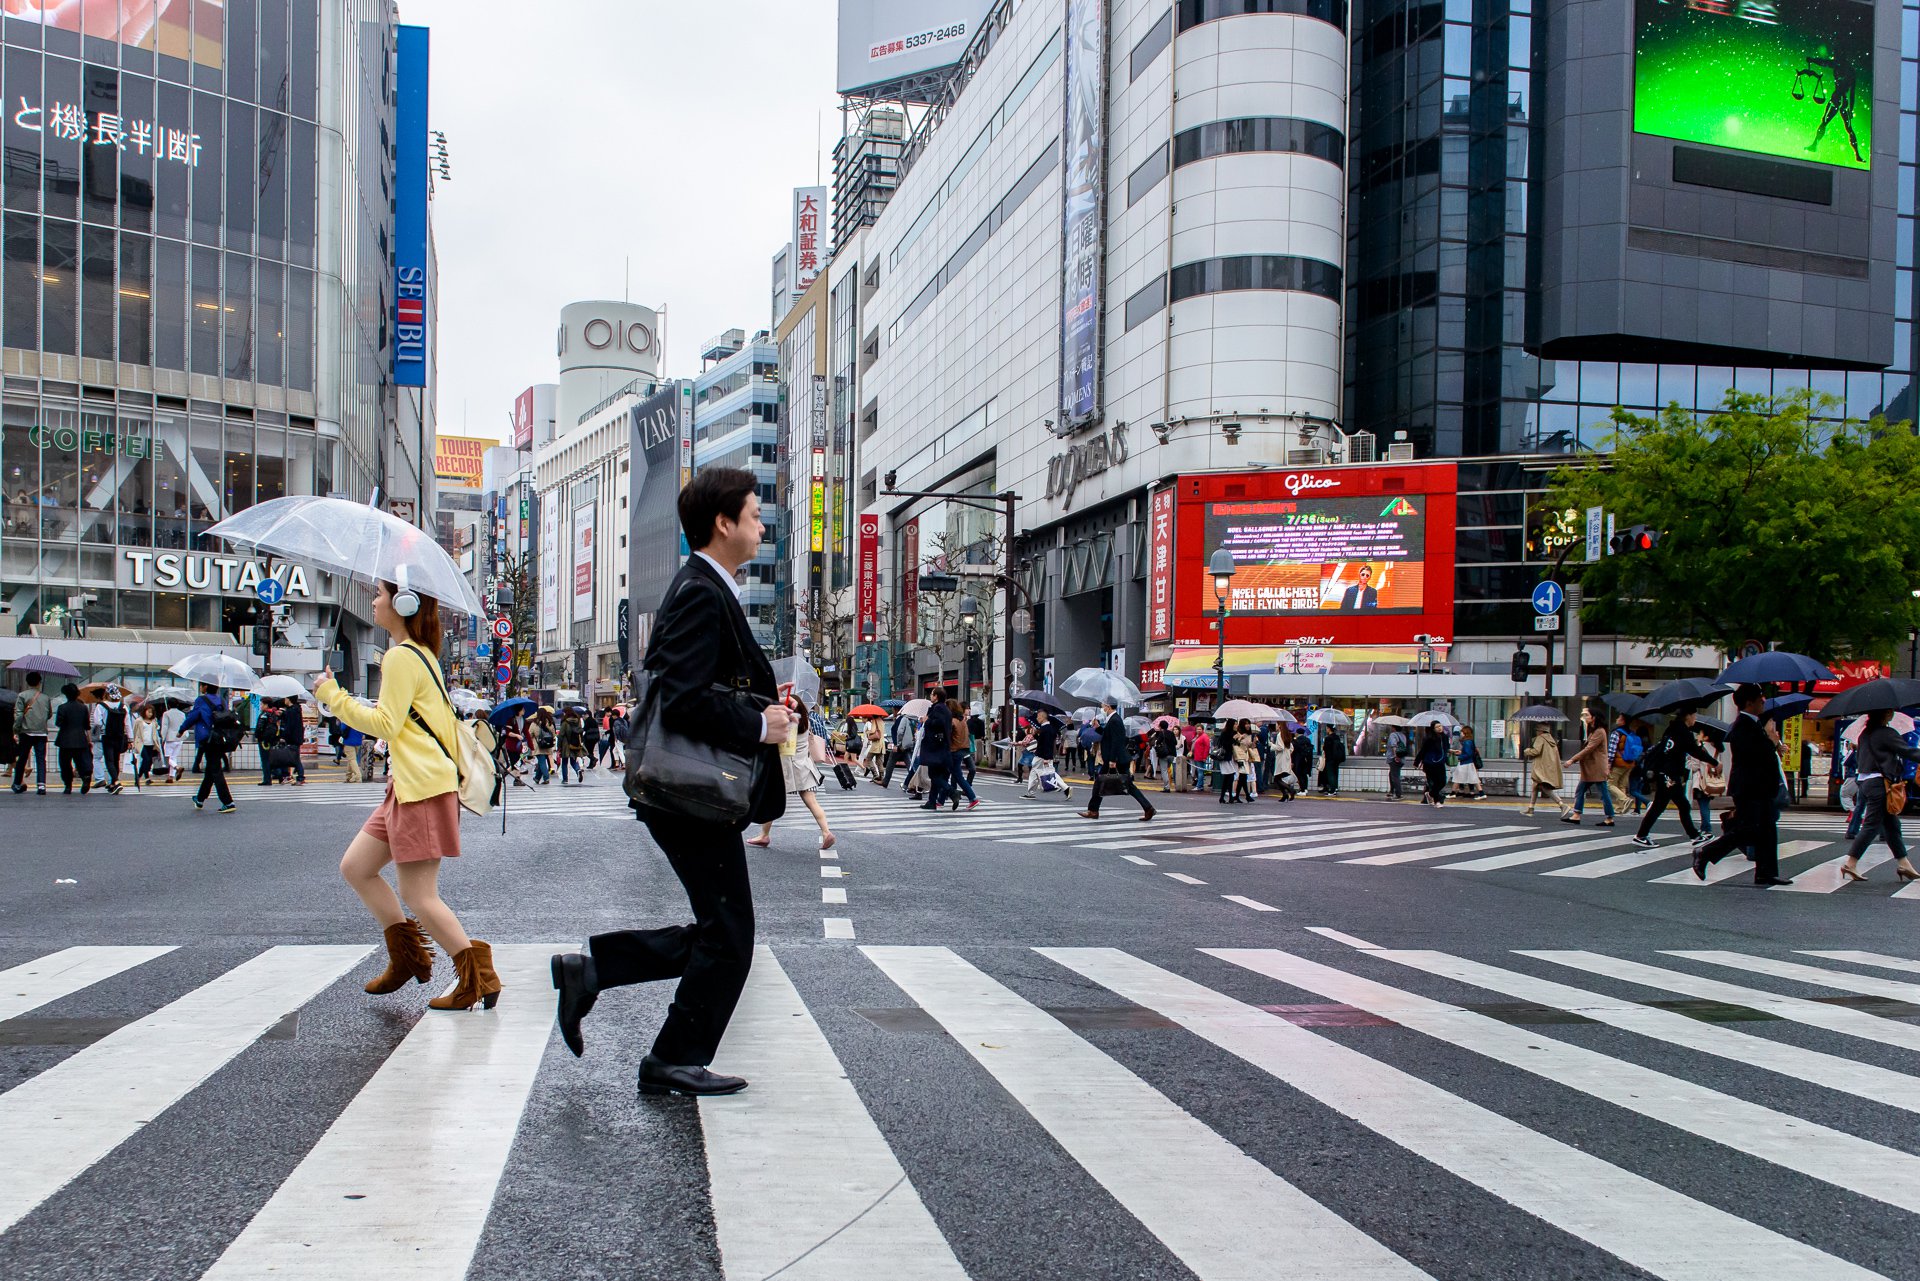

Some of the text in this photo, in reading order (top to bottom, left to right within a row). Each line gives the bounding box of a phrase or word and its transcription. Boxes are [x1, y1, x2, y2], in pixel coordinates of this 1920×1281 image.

[870, 23, 965, 58] 広告募集 5337-2468
[15, 95, 202, 167] と機長判断
[799, 194, 818, 270] 大和証券
[397, 266, 424, 363] SEIBU
[29, 424, 164, 461] COFFEE
[639, 403, 676, 451] ZARA
[441, 438, 482, 457] TOWER
[1284, 473, 1341, 496] Glico
[1154, 493, 1171, 513] 名物
[126, 551, 311, 597] TSUTAYA
[1155, 513, 1168, 636] 天津甘栗
[1232, 588, 1255, 599] NOEL
[1232, 598, 1318, 610] HIGH FLYING BIRDS
[620, 605, 628, 639] ZARA
